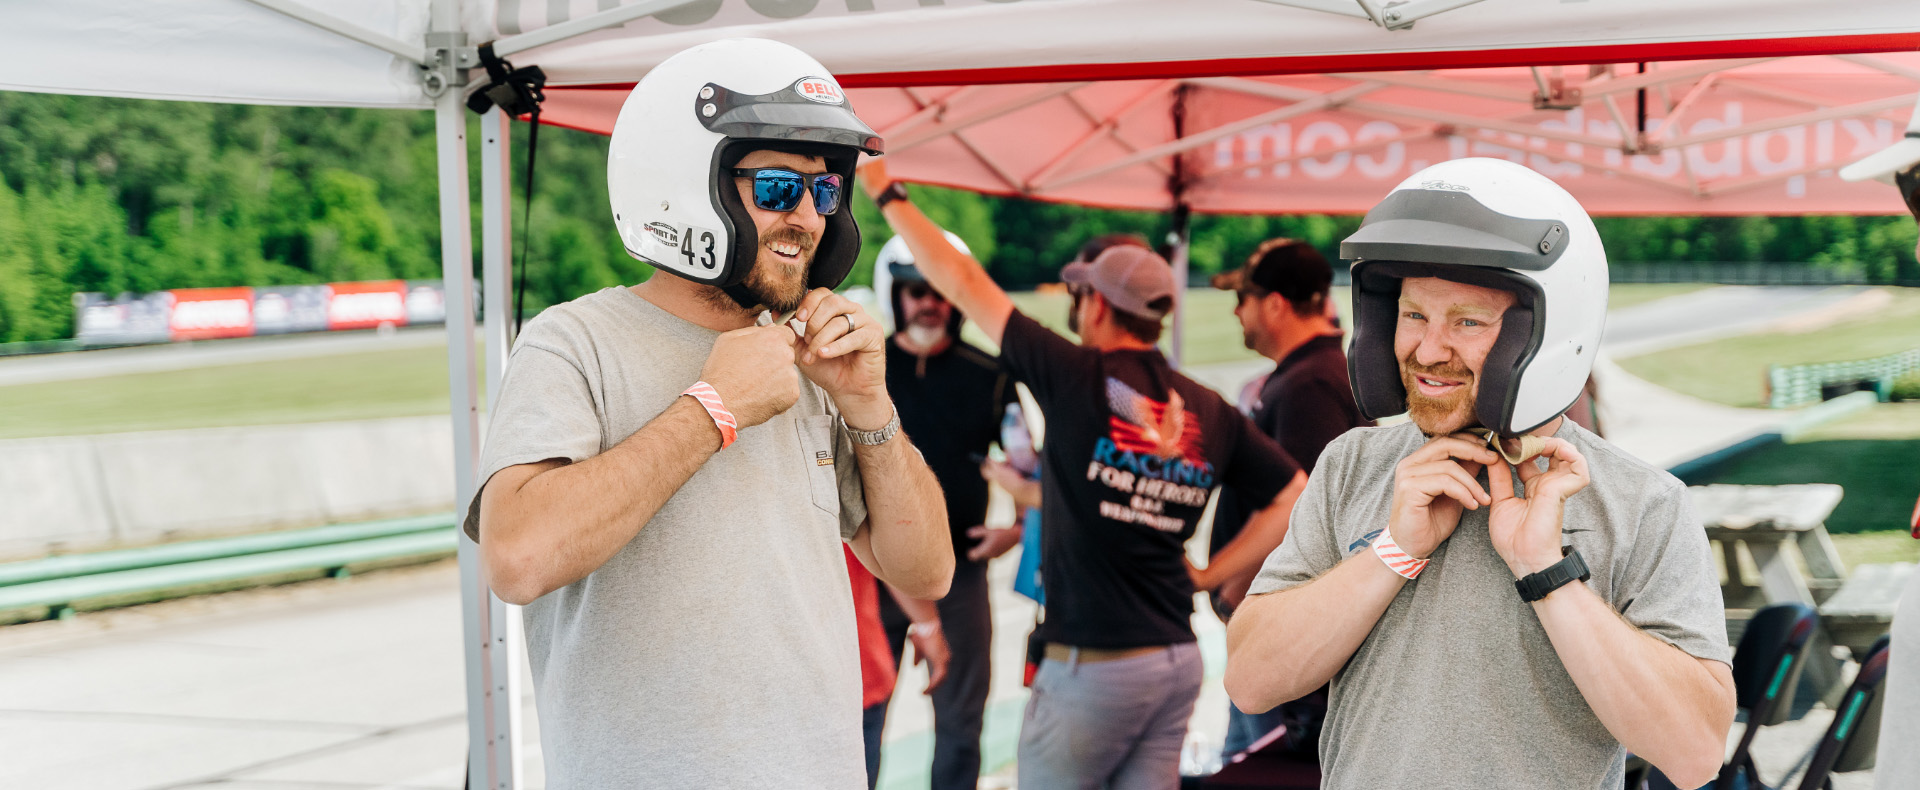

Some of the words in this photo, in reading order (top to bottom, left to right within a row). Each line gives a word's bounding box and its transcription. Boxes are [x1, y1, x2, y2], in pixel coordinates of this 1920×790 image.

[802, 82, 840, 98] BELL
[643, 223, 669, 239] SPORT
[681, 227, 716, 270] 43
[1086, 460, 1136, 494] FOR
[1092, 436, 1215, 488] RACING
